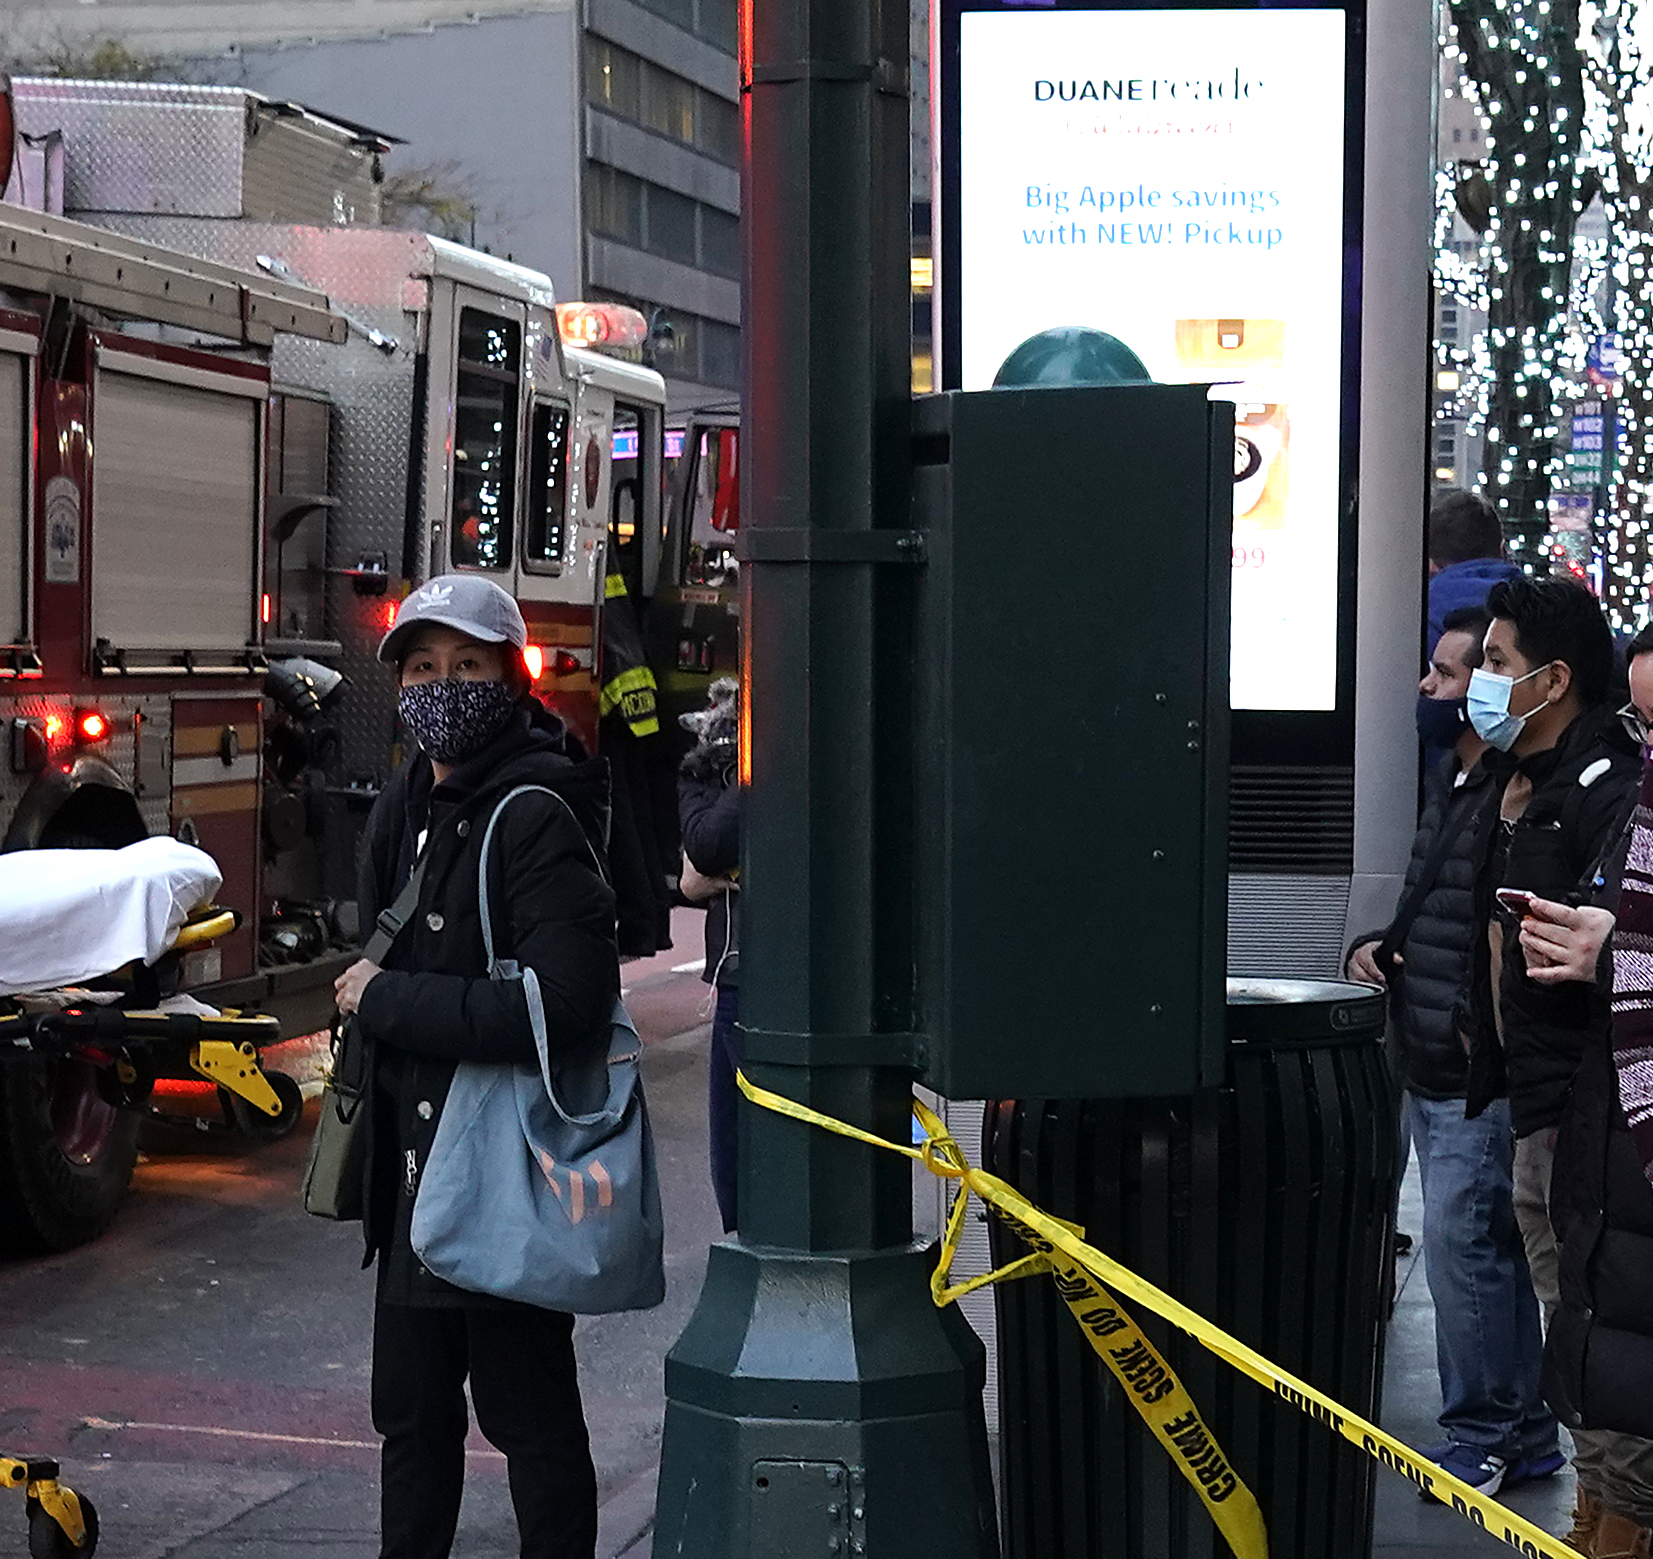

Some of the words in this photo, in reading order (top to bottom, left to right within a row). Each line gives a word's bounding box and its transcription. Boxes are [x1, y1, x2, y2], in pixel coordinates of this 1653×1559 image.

[1035, 80, 1142, 101] DUANE
[1027, 182, 1070, 215] Big
[1079, 184, 1161, 213] Apple
[1171, 182, 1280, 214] savings
[1023, 221, 1086, 244] with
[1098, 222, 1172, 244] NEW!
[1186, 221, 1282, 250] Pickup
[1109, 1338, 1176, 1405] SCENE
[1162, 1410, 1237, 1503] CRIME
